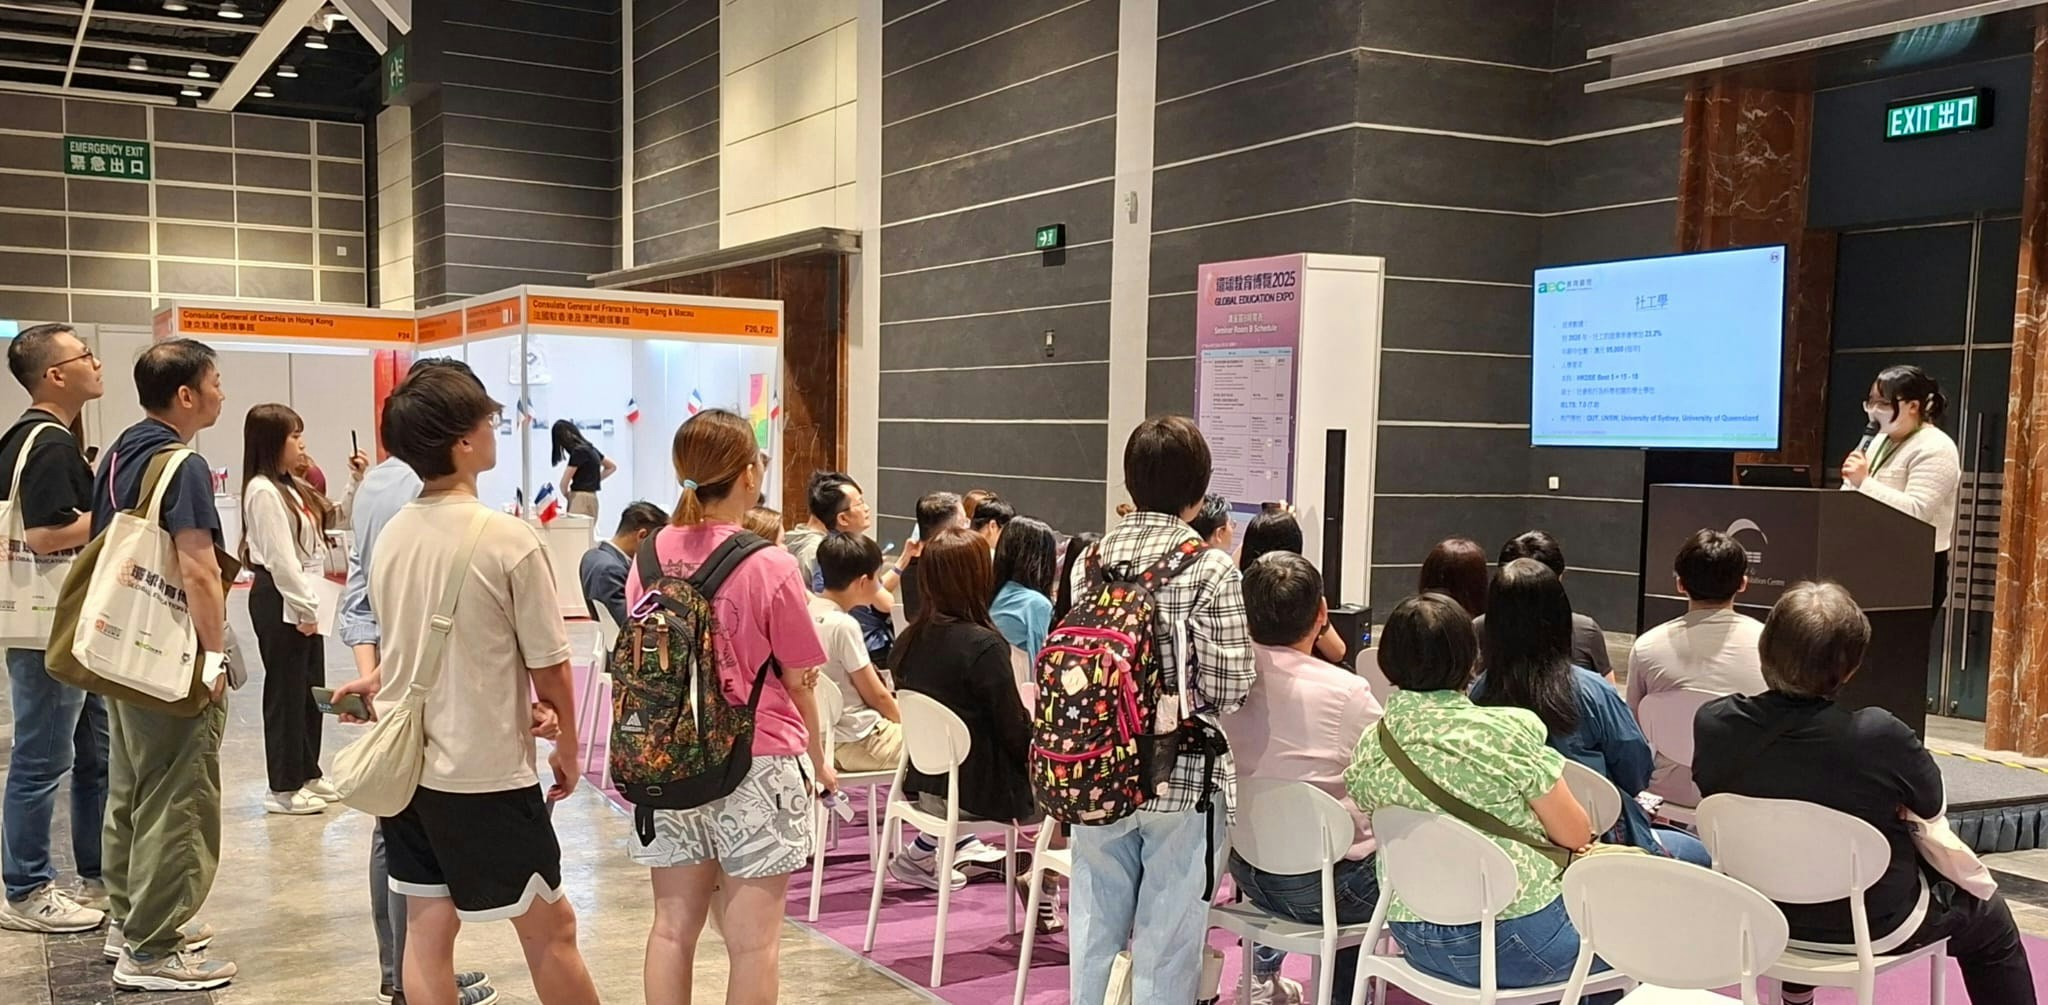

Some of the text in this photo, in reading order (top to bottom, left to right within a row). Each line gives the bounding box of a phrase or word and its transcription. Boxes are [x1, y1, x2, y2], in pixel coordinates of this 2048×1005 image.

[1891, 98, 1974, 136] EXIT 出口
[70, 141, 144, 157] EMERGENCY EXIT
[70, 154, 144, 174] 緊急出口
[1215, 291, 1295, 306] GLOBAL EDUCATION EXPO
[533, 300, 695, 318] Consulate General of France in Hong Kong & Macau
[183, 311, 334, 327] Consulate General of Czechia in Hong Kong
